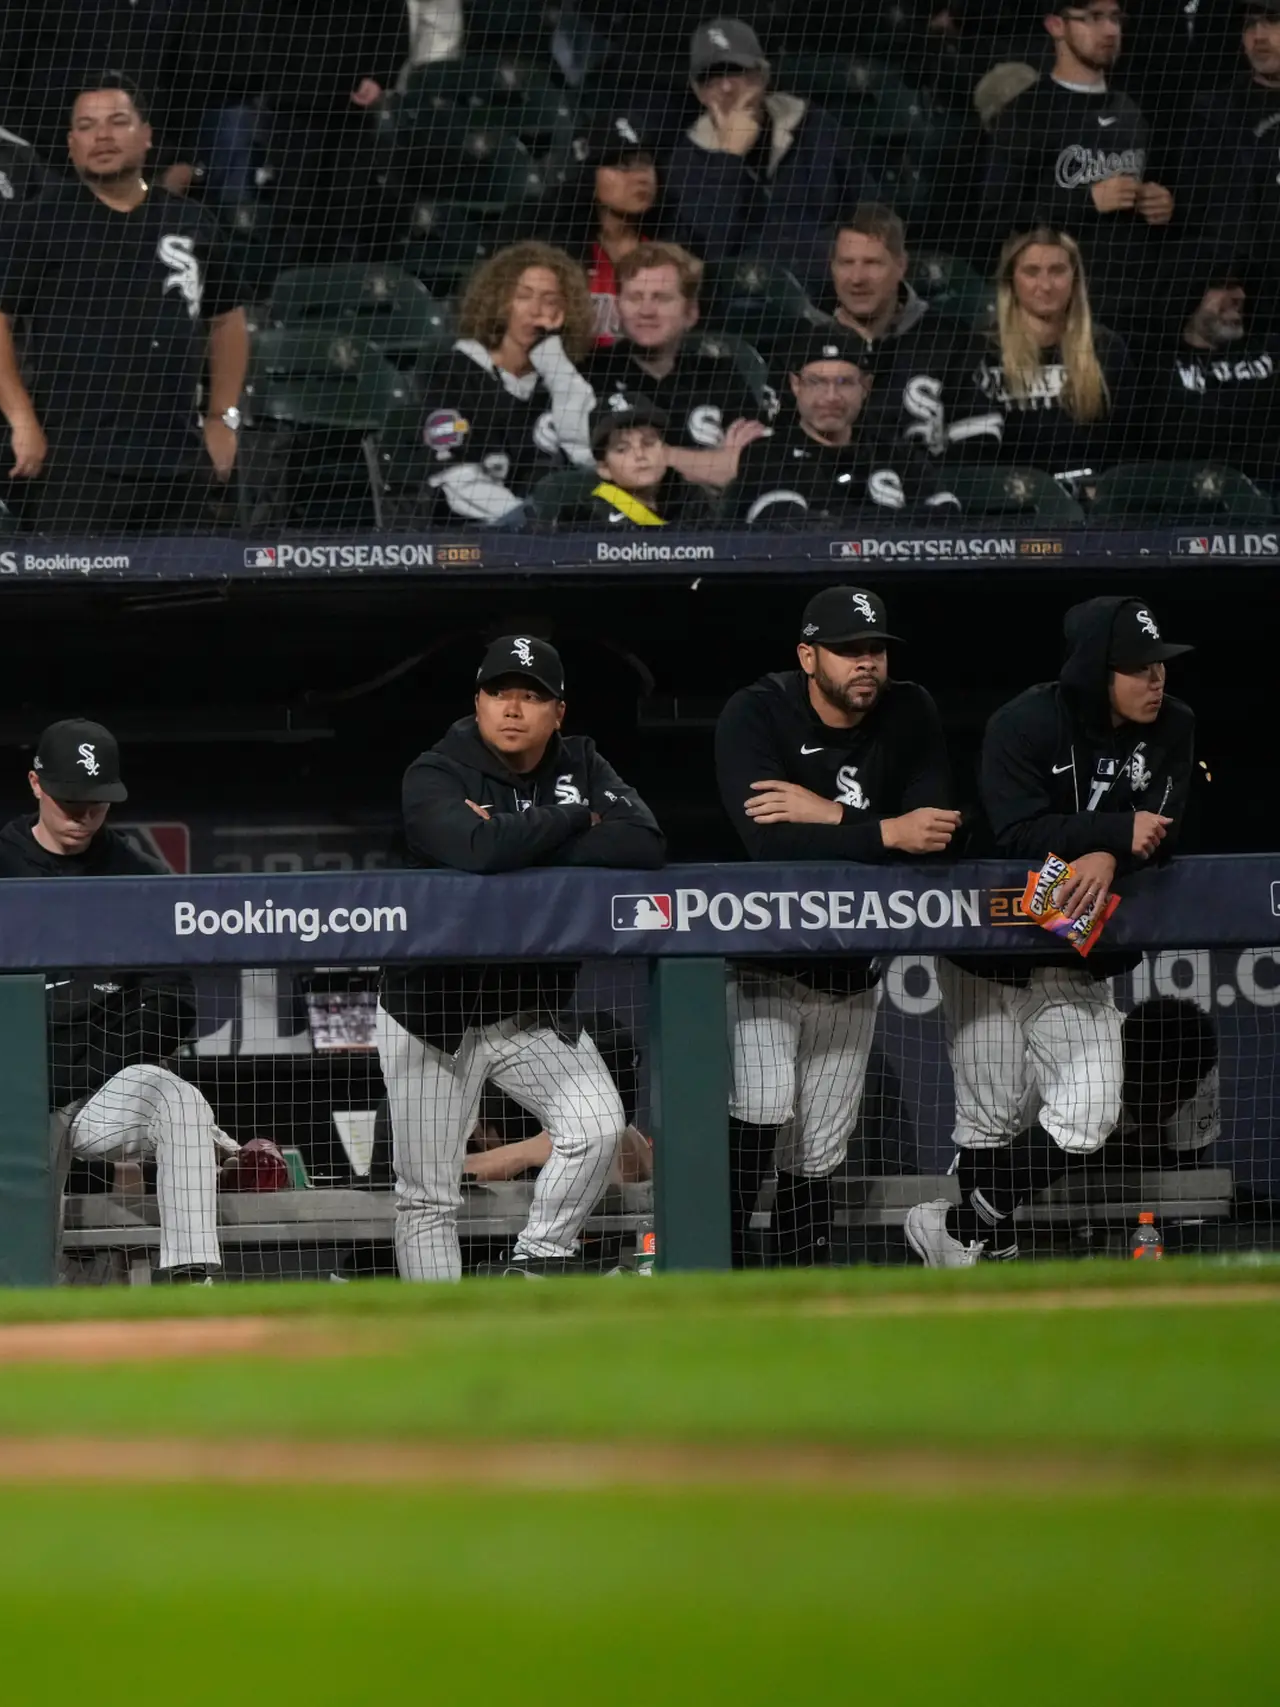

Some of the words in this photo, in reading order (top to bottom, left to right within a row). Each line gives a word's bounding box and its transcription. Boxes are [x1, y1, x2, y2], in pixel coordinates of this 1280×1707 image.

[277, 545, 434, 568] POSTSEASON
[597, 542, 714, 561] Booking.com
[862, 539, 1016, 562] POSTSEASON
[1210, 534, 1279, 556] ALDS
[24, 554, 129, 573] Booking.com
[852, 594, 877, 622] Sox
[510, 638, 534, 667] Sox
[76, 743, 100, 775] Sox
[1030, 857, 1066, 916] GIANTS
[174, 899, 407, 942] Booking.com
[675, 889, 982, 932] POSTSEASON
[989, 897, 1025, 917] 20
